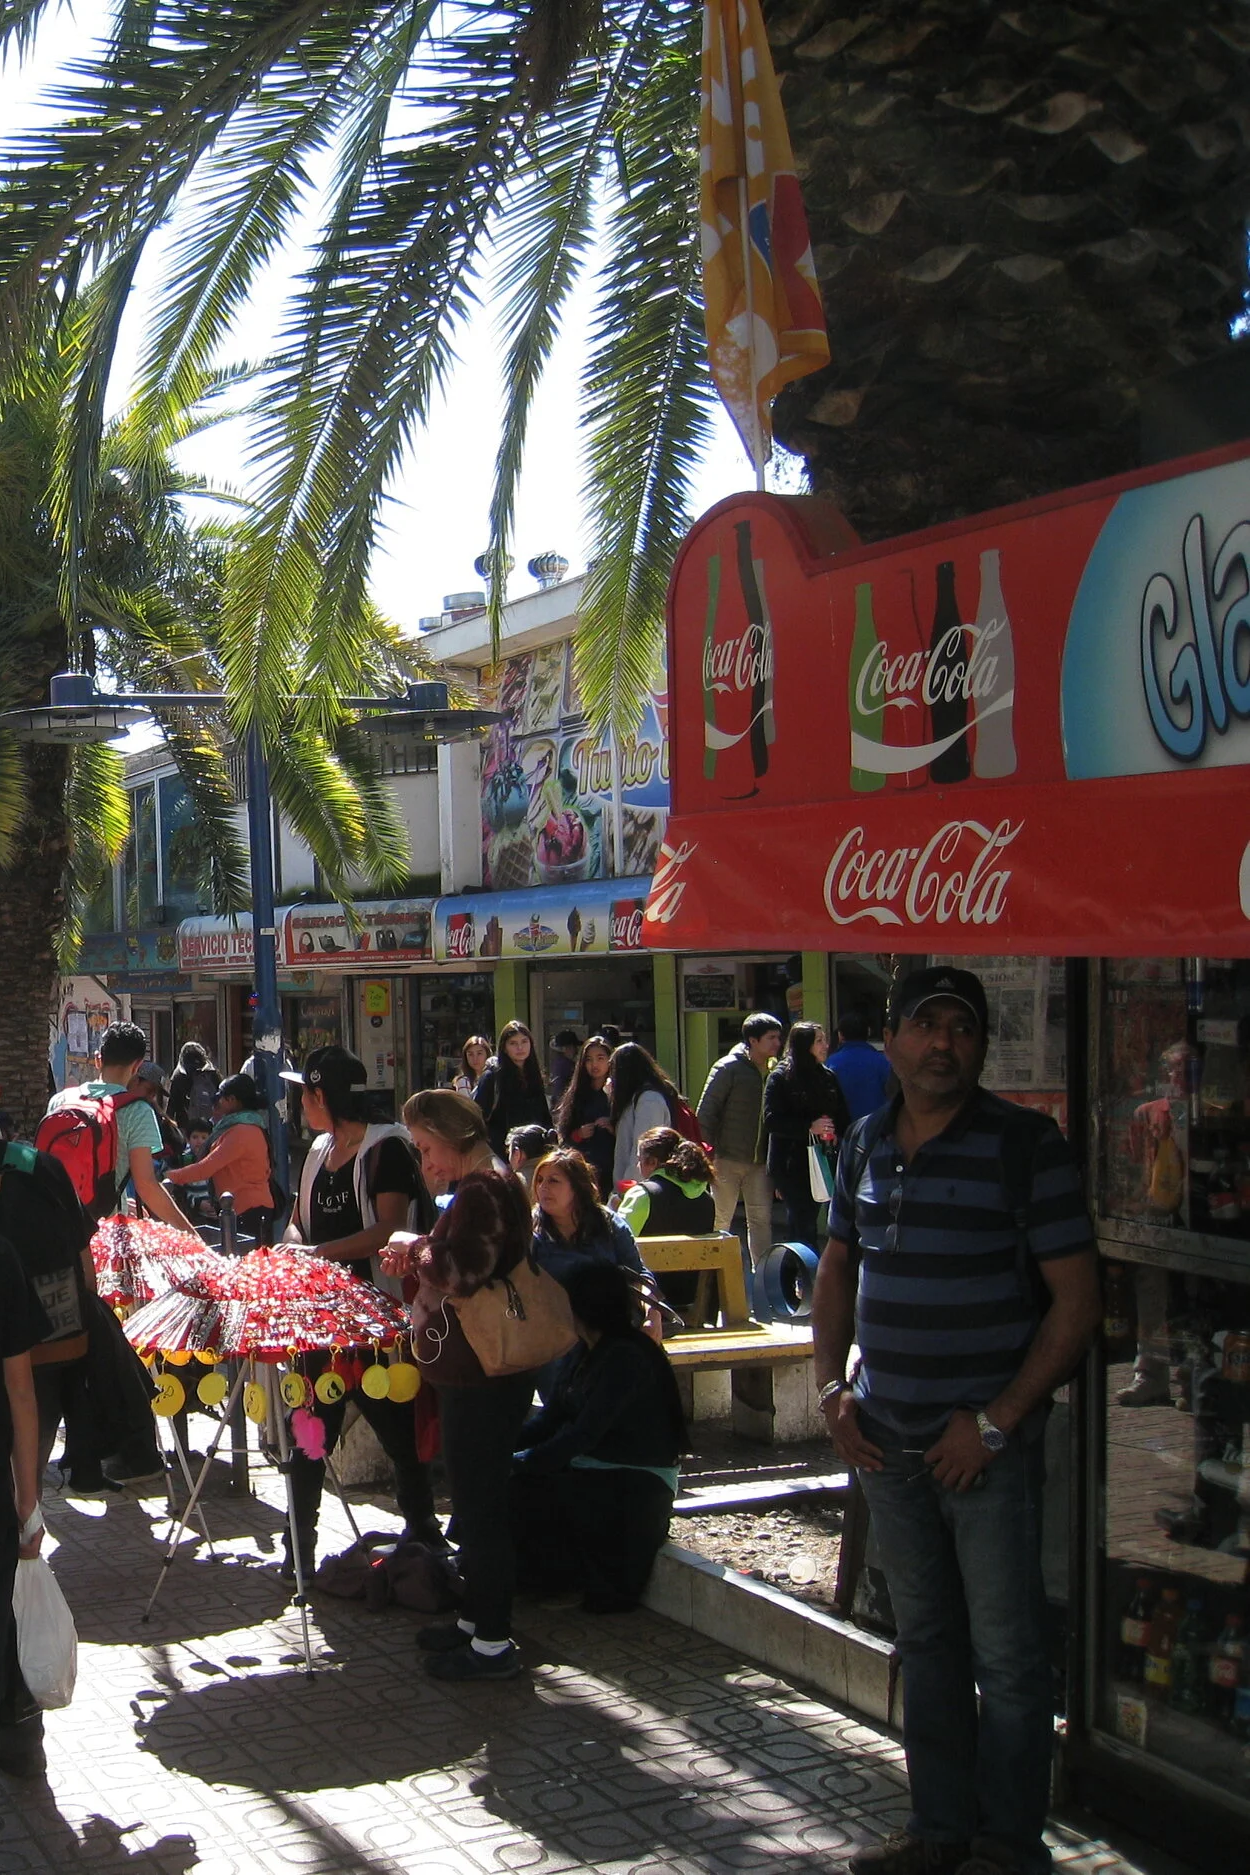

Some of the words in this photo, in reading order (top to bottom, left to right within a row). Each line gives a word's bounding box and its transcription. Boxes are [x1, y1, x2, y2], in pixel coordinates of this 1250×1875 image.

[855, 617, 1009, 716] Coca-Cola
[823, 817, 1025, 926] Coca-Cola
[181, 933, 229, 958] SERVICIO
